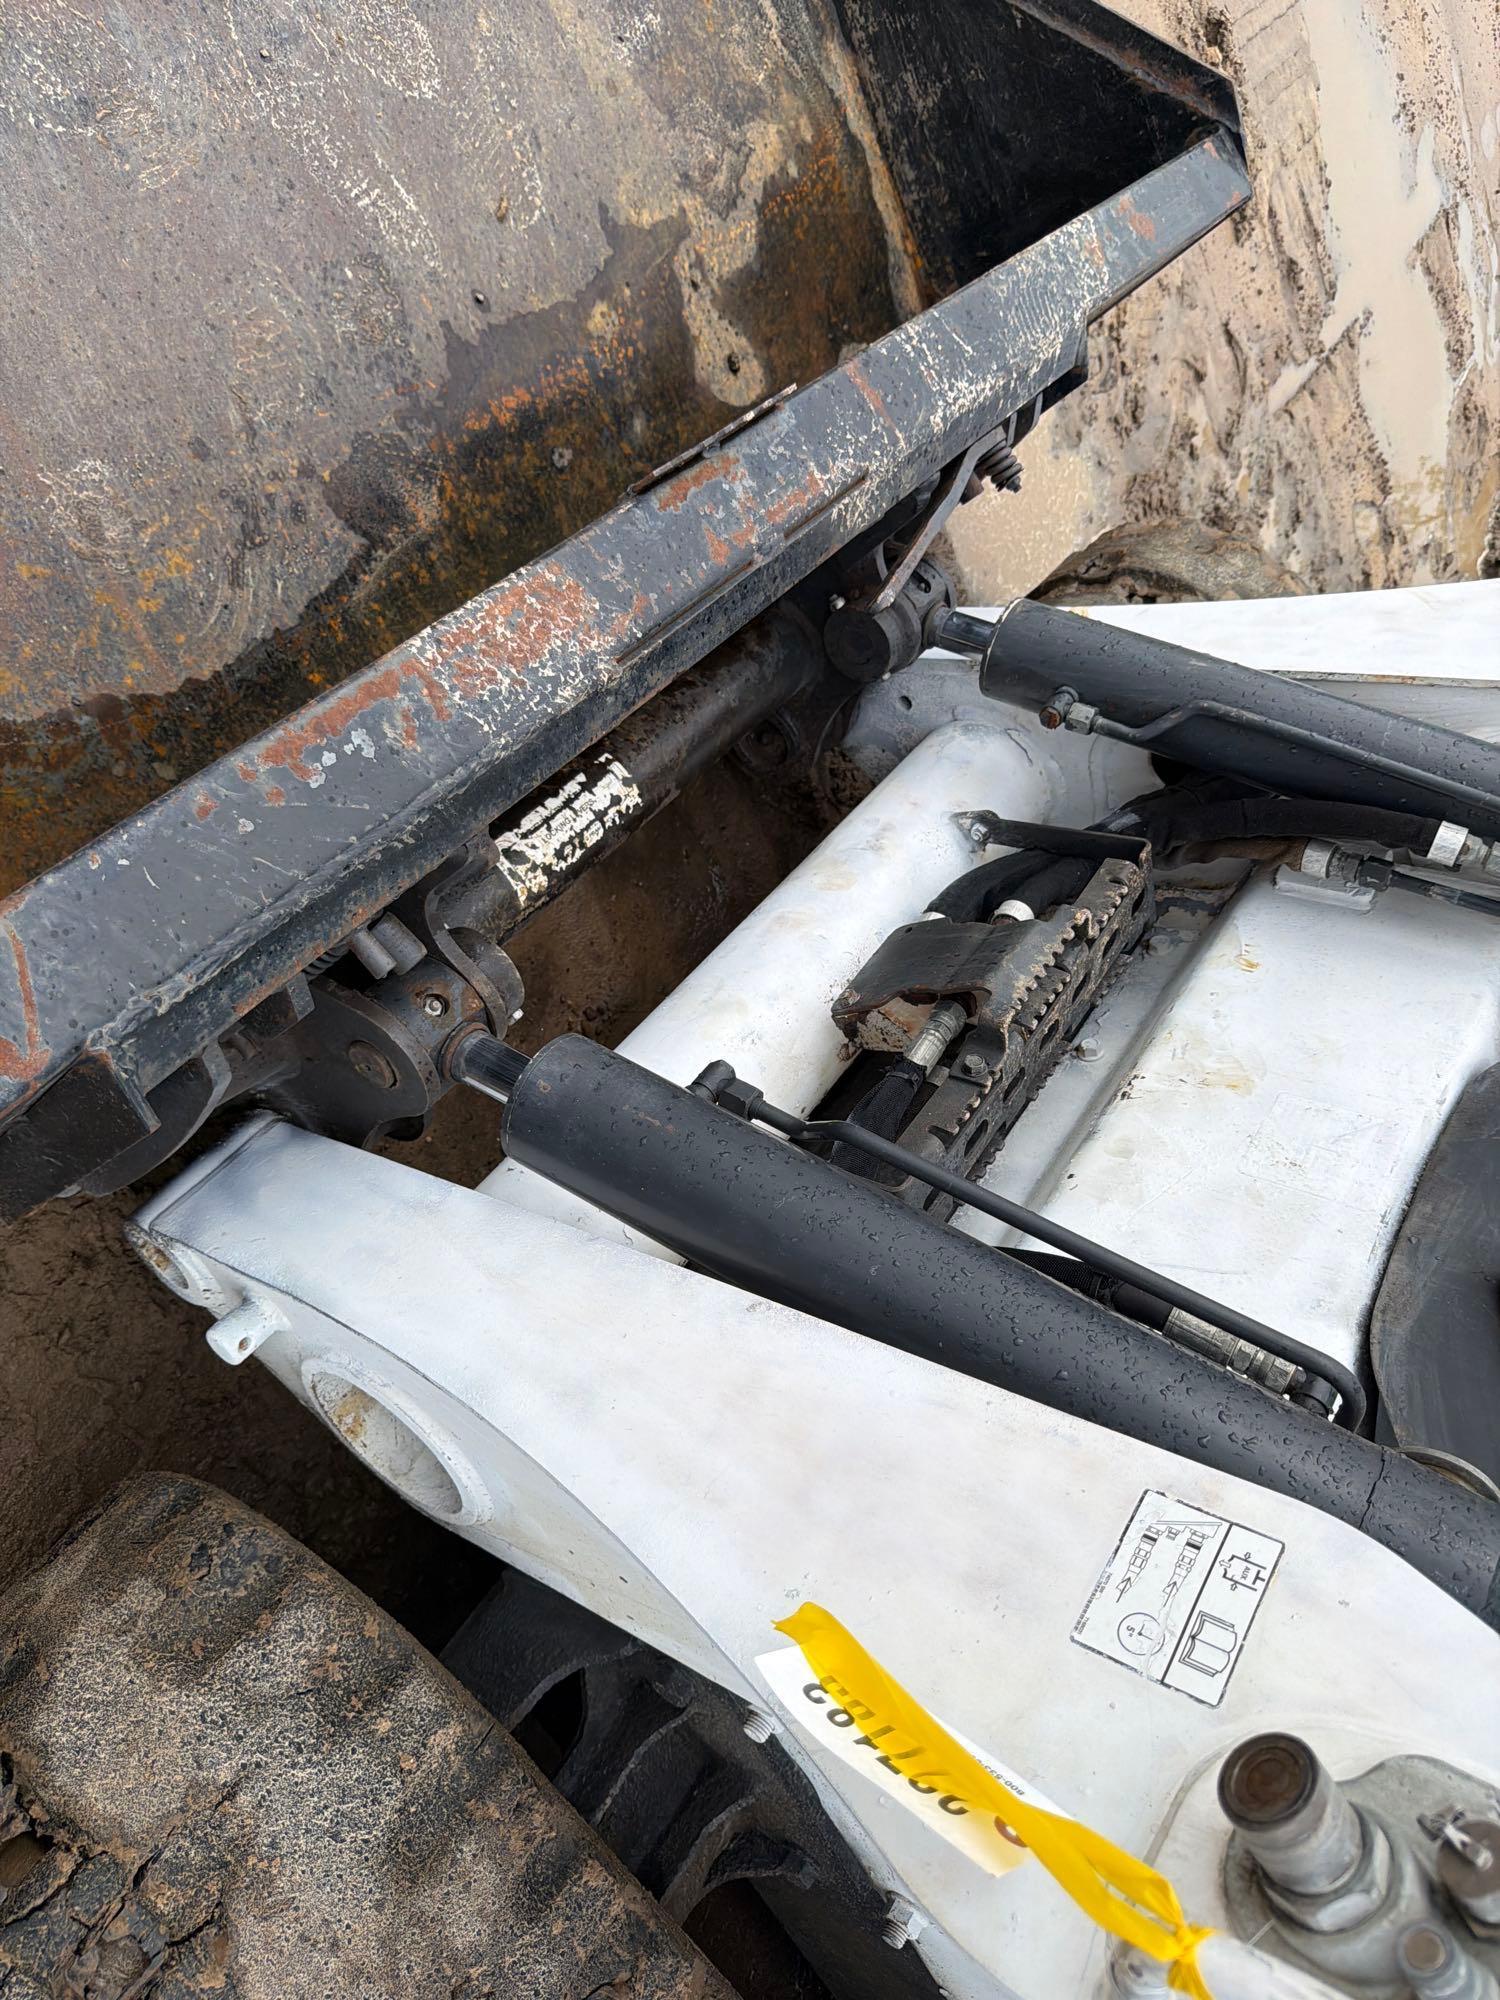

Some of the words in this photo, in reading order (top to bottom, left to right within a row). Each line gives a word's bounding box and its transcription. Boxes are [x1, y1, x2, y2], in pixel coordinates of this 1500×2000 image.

[541, 816, 572, 844] LOCKING
[570, 799, 597, 824] LVERS.
[1241, 1566, 1250, 1580] AUX
